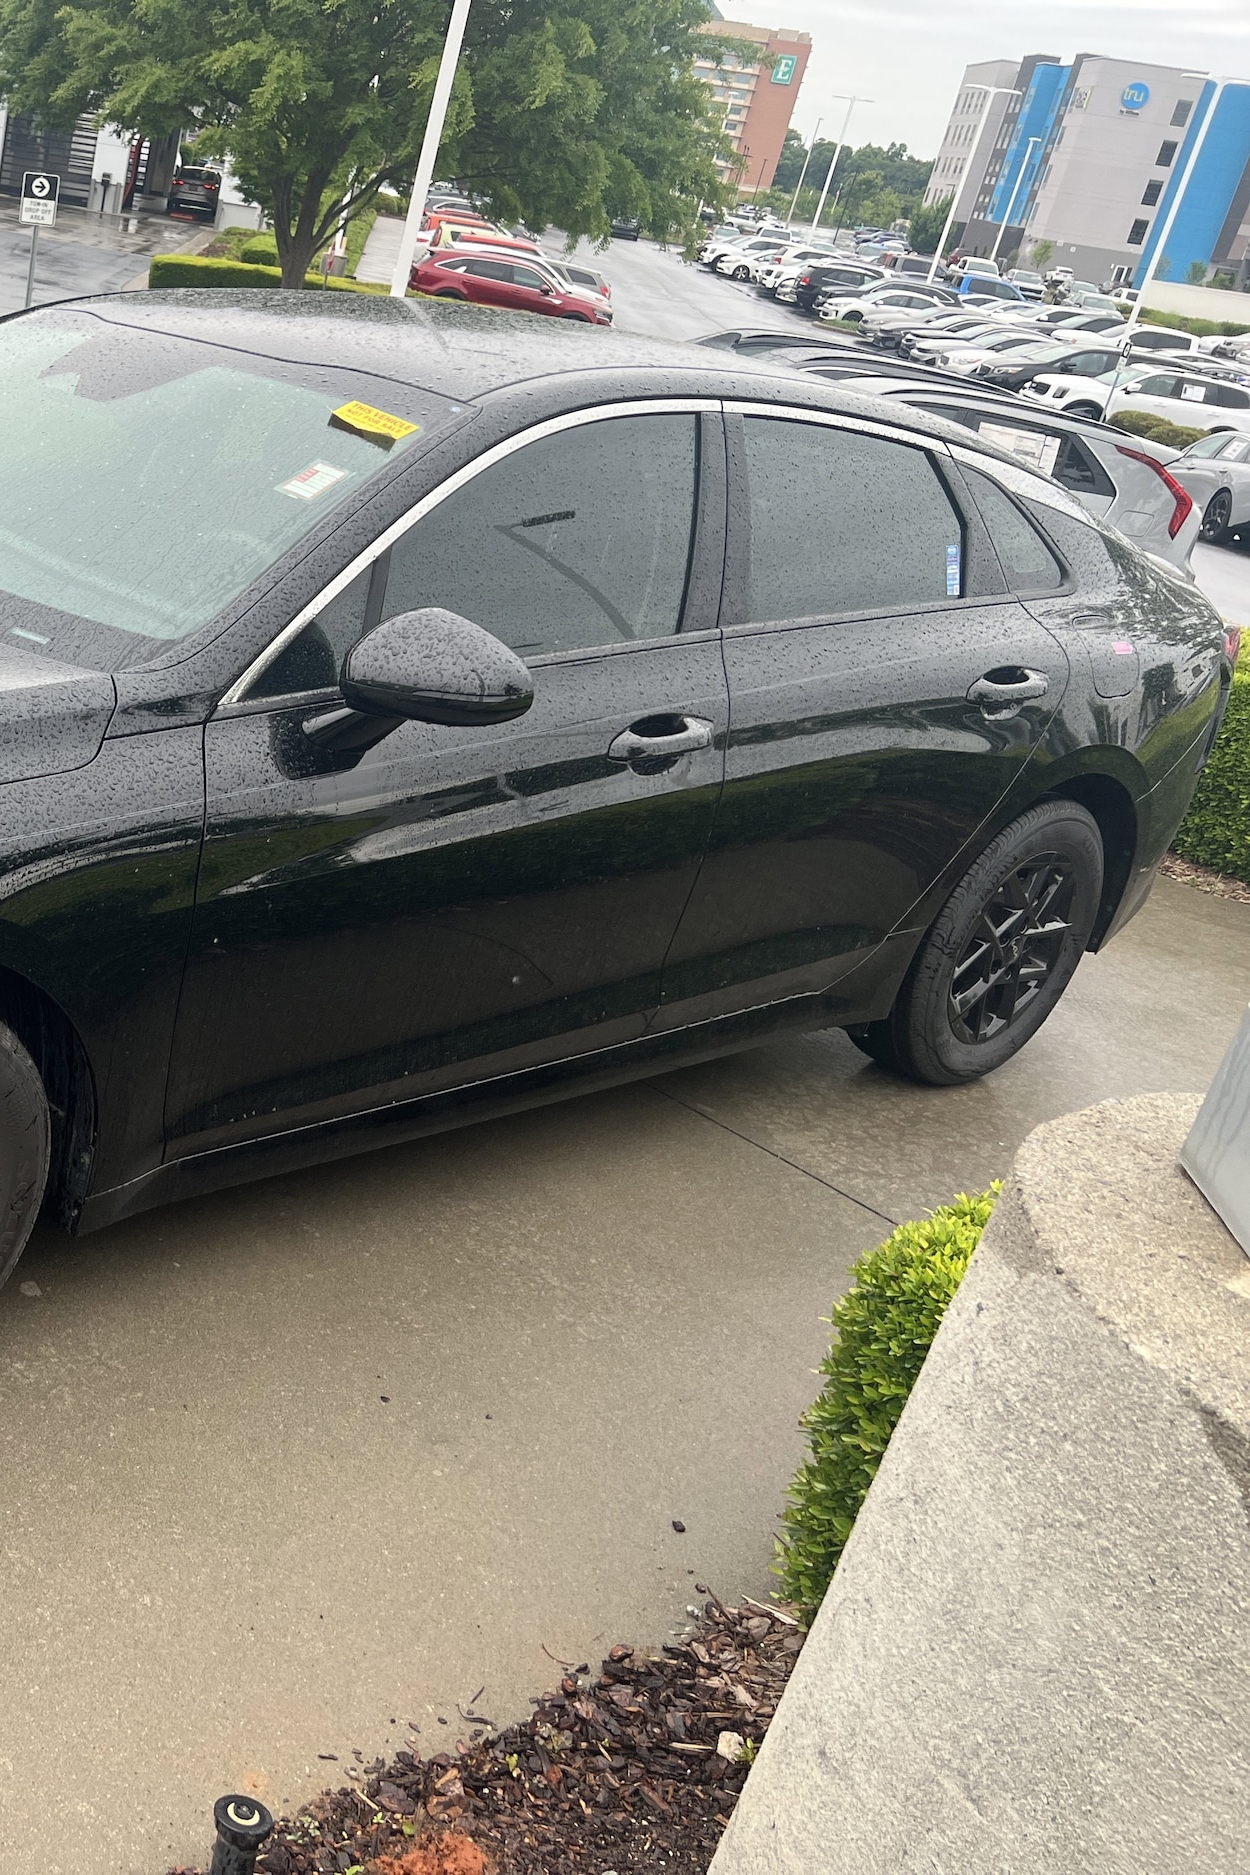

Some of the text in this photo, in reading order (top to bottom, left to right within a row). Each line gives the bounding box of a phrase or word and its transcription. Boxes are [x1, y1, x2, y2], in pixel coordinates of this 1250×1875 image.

[1123, 87, 1145, 103] tru
[347, 408, 404, 434] NOT FOR SALE
[352, 403, 413, 431] THIS VEHICLE
